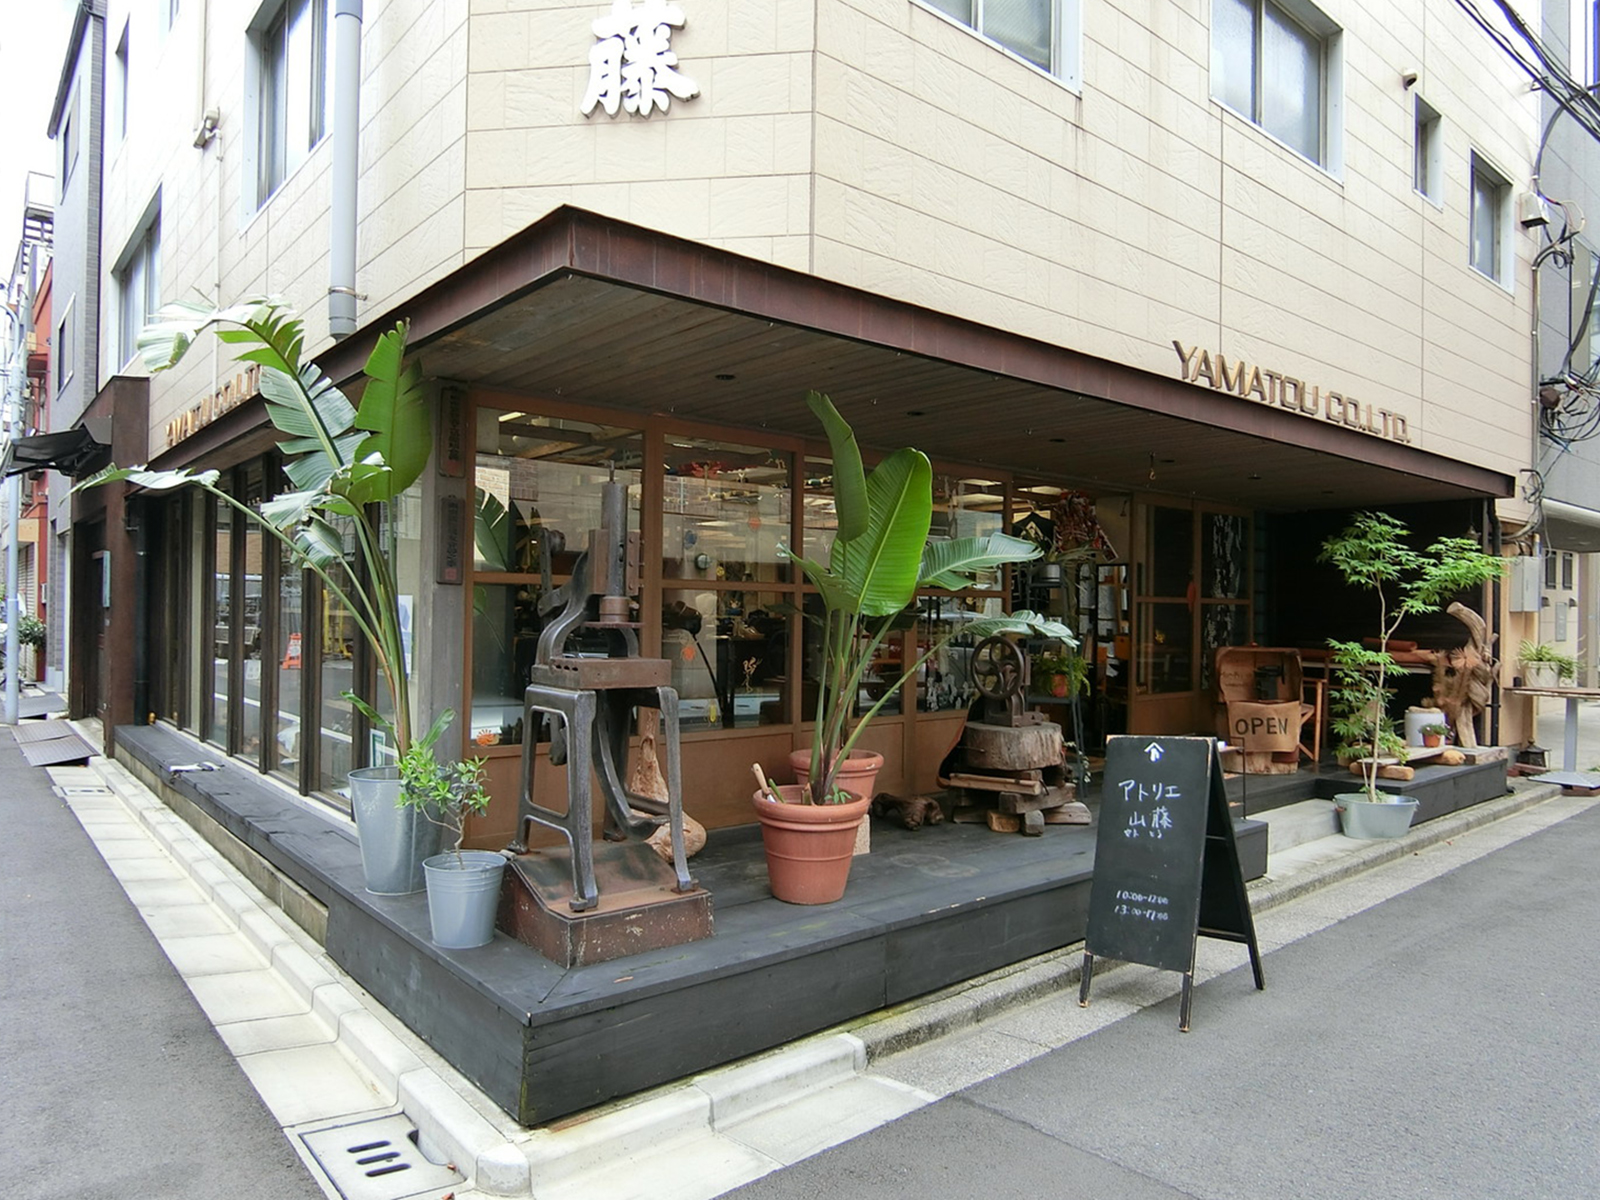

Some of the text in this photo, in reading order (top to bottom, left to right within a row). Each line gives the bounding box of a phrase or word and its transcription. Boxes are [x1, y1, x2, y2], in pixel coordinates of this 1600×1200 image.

[580, 0, 700, 119] 藤
[1172, 340, 1319, 416] YAMATOU
[1235, 717, 1288, 735] OPEN
[1118, 779, 1181, 801] アトリエ
